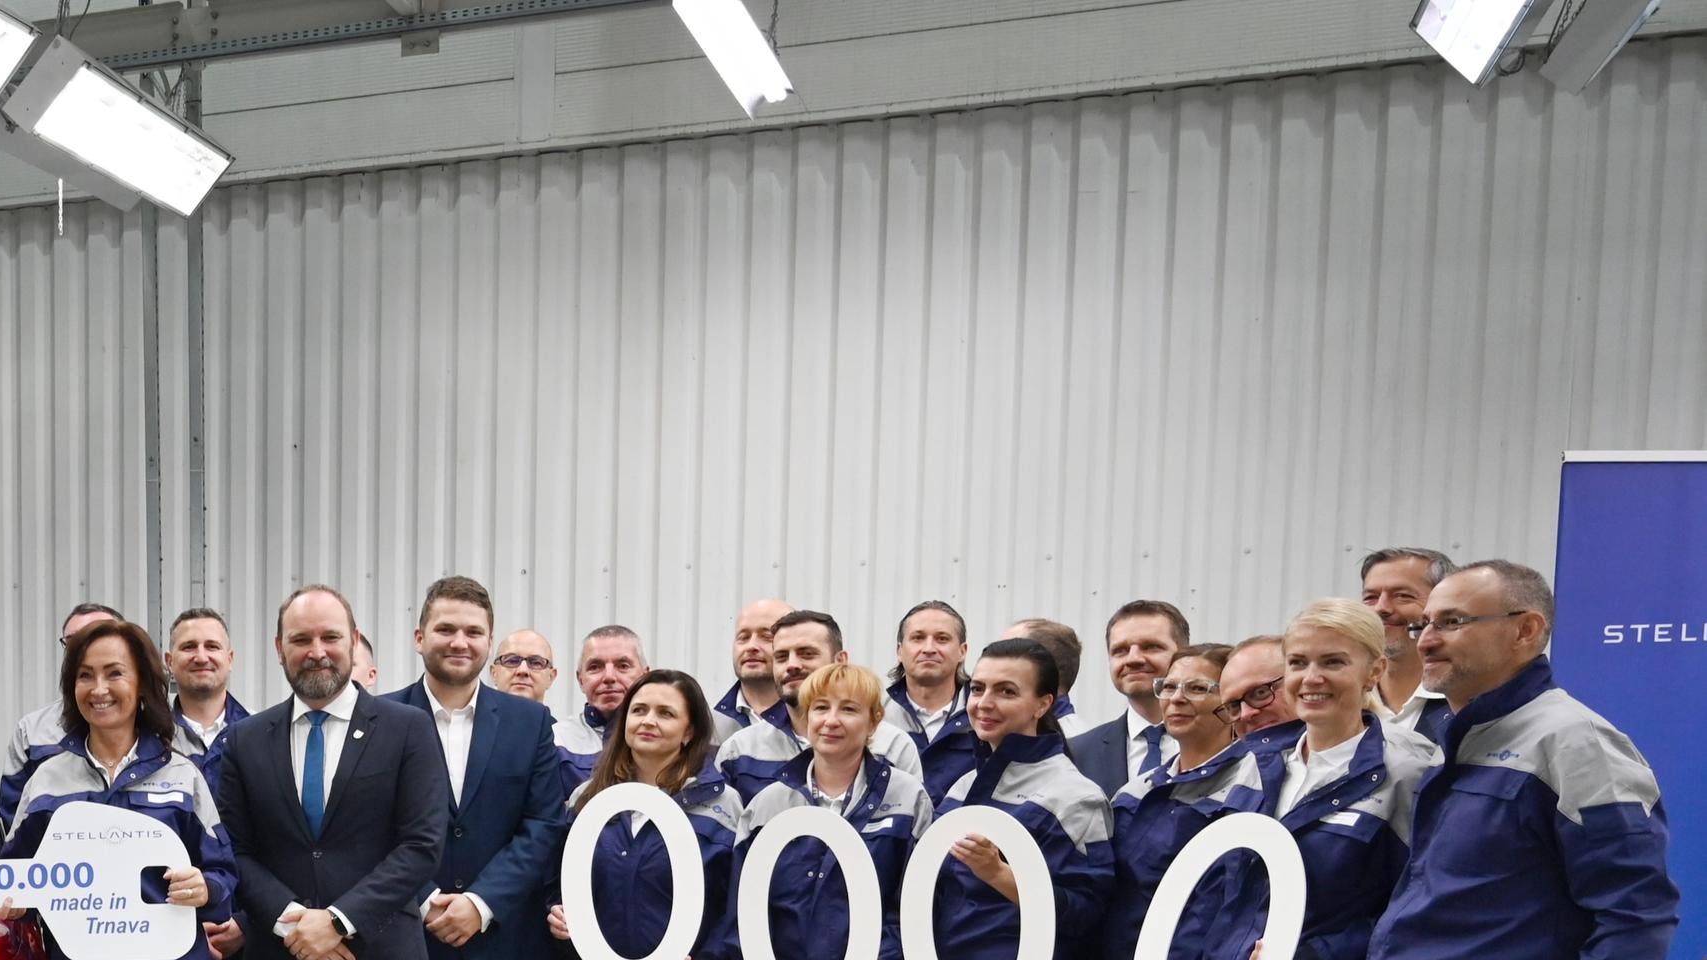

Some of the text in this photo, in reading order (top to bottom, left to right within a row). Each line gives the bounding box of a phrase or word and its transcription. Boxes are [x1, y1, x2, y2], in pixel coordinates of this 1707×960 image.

[52, 830, 163, 841] STELLANTIS
[50, 893, 127, 911] made in
[86, 917, 151, 935] Trnava
